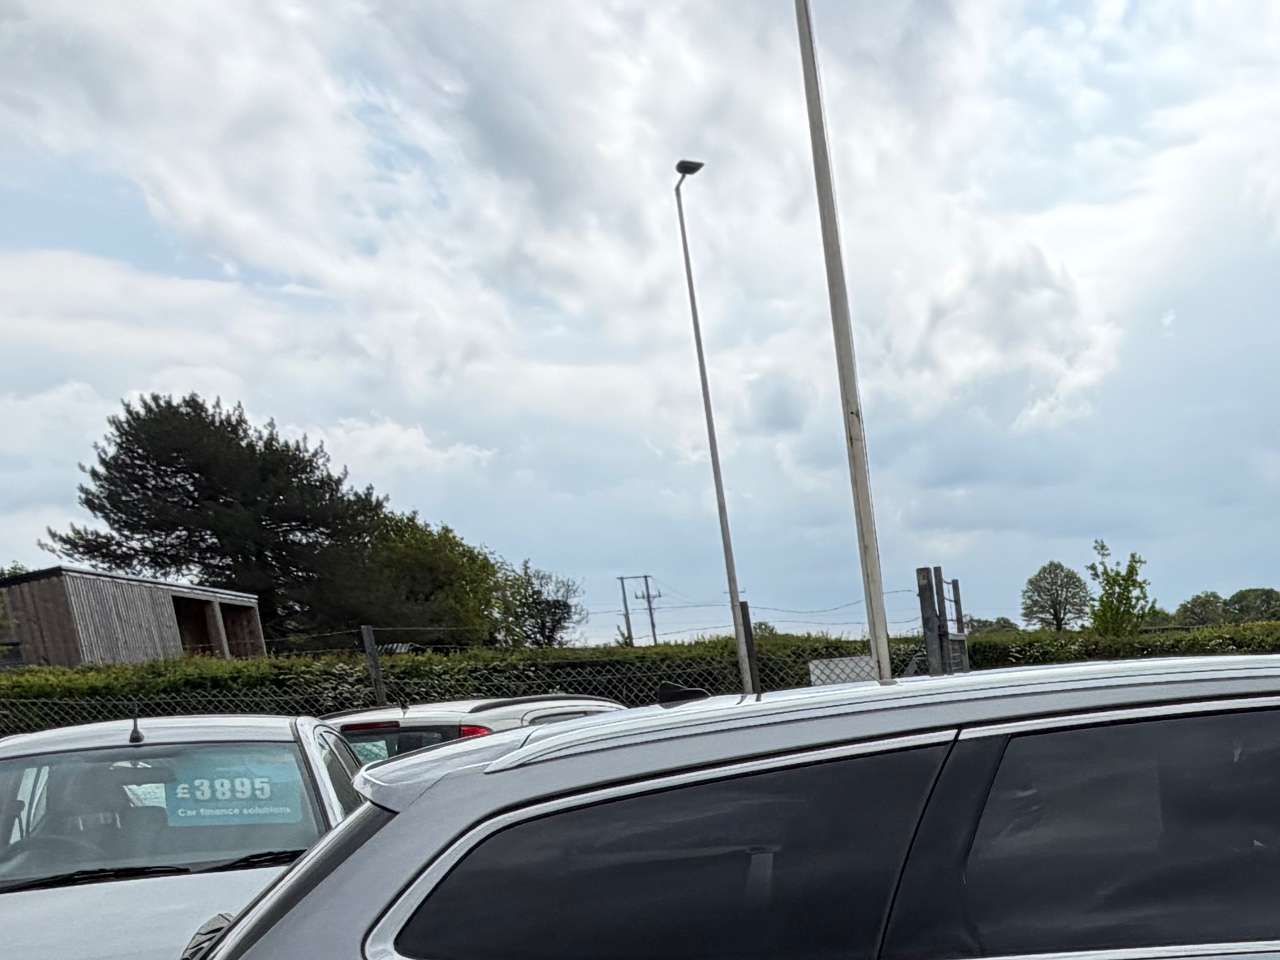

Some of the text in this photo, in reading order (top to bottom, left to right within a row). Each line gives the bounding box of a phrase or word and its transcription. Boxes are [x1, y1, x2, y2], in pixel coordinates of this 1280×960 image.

[175, 776, 272, 801] £3895
[177, 807, 197, 817] Car
[199, 807, 241, 817] finance
